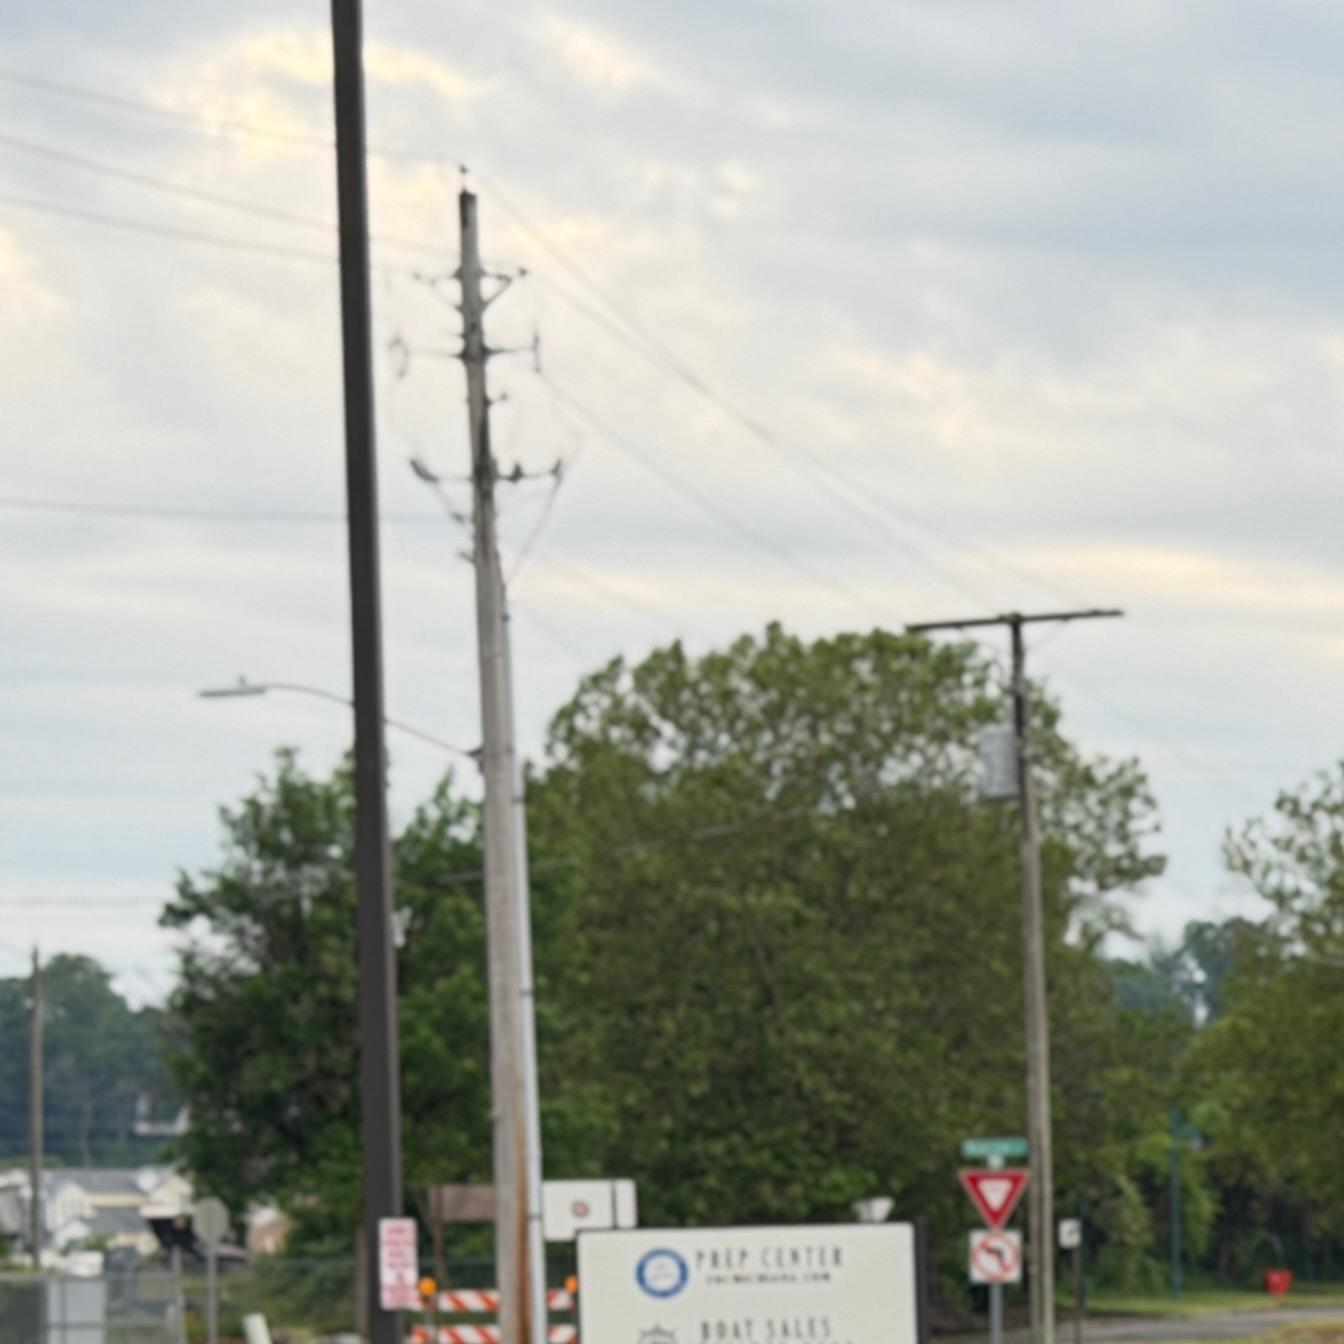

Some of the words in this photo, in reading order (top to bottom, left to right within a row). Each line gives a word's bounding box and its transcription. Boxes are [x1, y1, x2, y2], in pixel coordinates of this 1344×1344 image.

[696, 1248, 748, 1269] PREP
[761, 1246, 843, 1268] CENTER
[701, 1319, 752, 1340] BOAT
[766, 1317, 831, 1339] SALES
